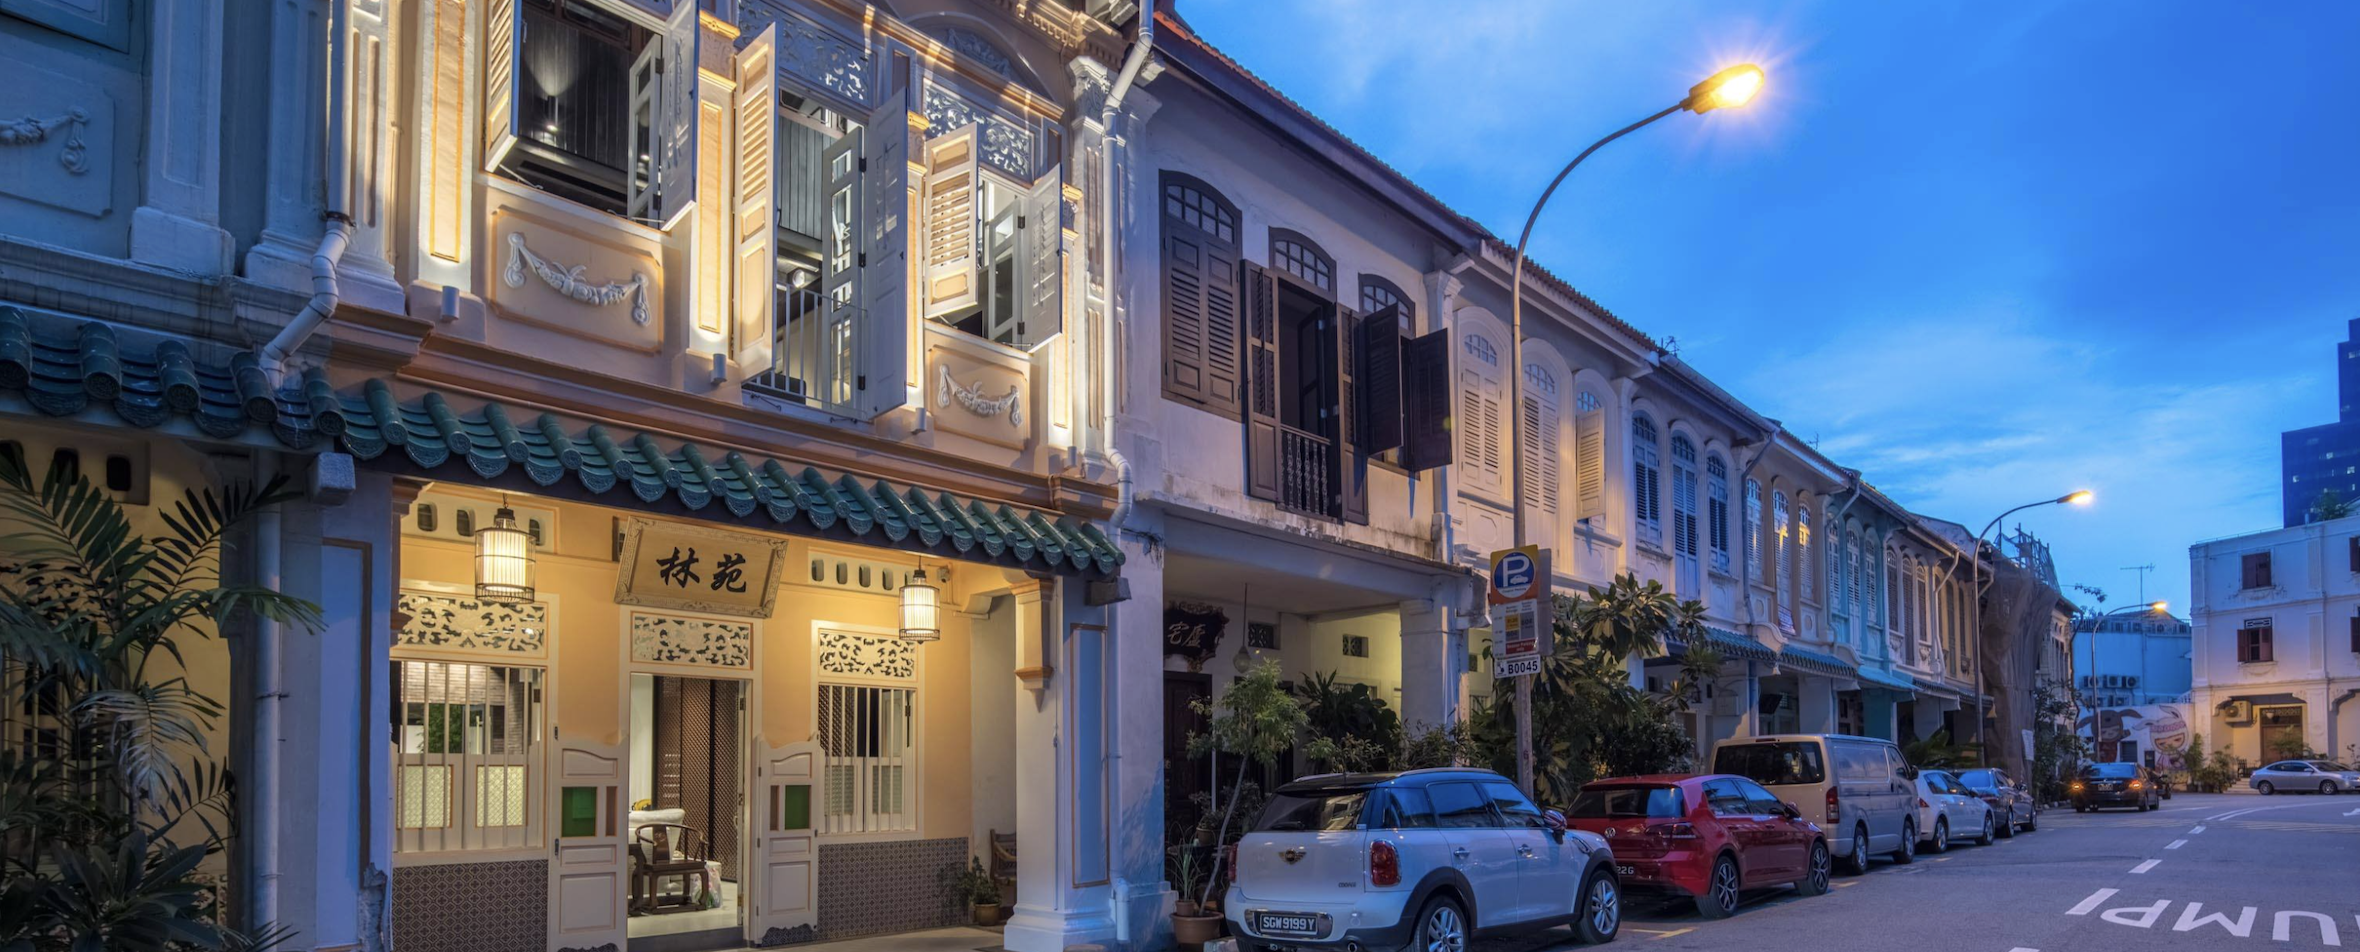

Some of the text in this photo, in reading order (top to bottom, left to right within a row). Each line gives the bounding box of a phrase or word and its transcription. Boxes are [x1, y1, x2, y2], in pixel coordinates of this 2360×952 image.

[1502, 555, 1530, 587] P
[1508, 660, 1538, 674] B0045
[2100, 899, 2360, 947] UMP
